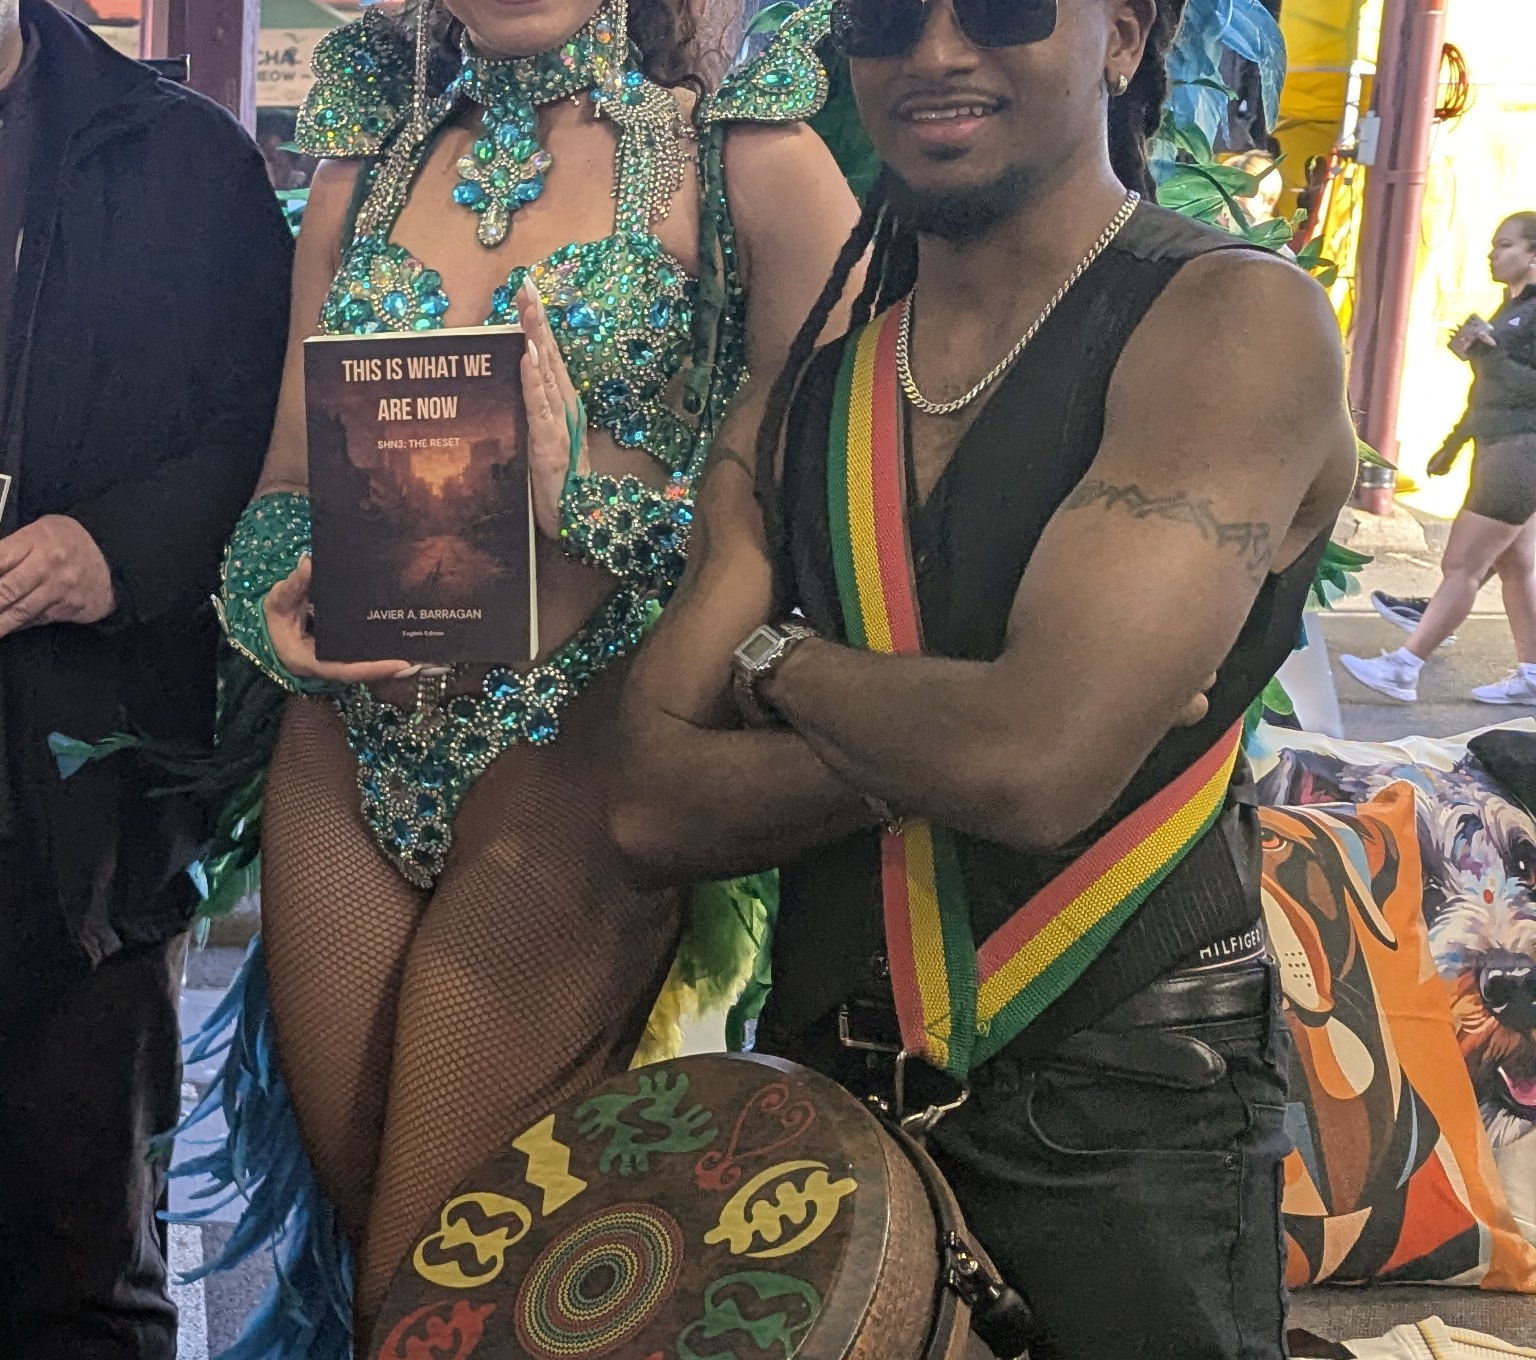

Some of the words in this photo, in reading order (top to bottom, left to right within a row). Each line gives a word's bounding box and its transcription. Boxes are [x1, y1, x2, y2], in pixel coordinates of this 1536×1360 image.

[342, 358, 382, 383] THIS
[386, 357, 403, 380] IS
[407, 355, 459, 379] WHAT
[464, 354, 492, 377] WE
[378, 397, 413, 422] ARE
[416, 396, 459, 420] NOW
[377, 440, 407, 449] SHN3:
[408, 439, 428, 449] THE
[430, 437, 460, 447] RESET
[367, 609, 405, 620] JAVIER
[407, 610, 418, 620] A.
[420, 608, 482, 620] BARRAGAN
